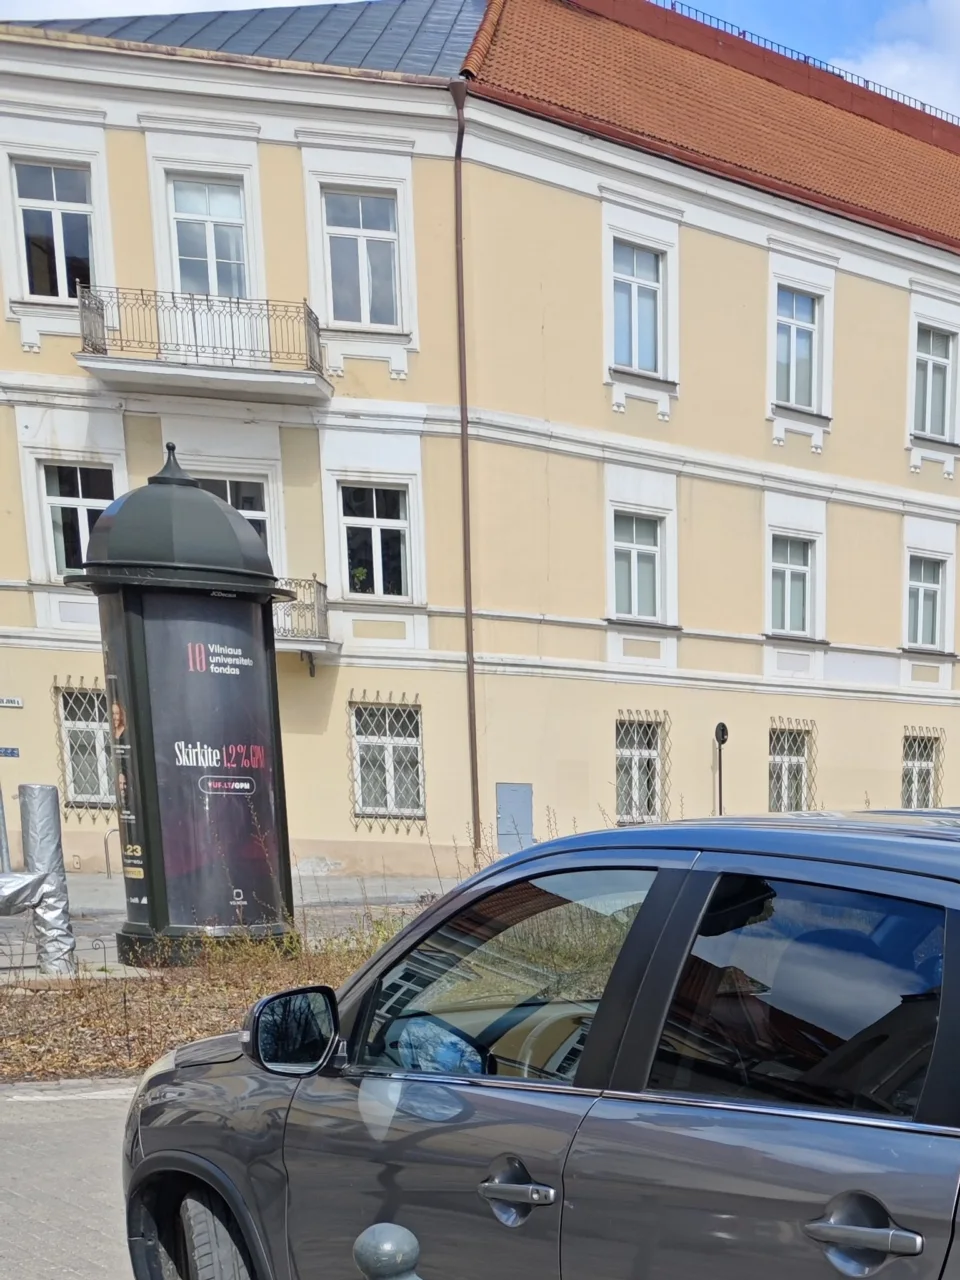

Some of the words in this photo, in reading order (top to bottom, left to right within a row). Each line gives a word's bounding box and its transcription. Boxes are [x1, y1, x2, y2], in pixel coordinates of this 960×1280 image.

[207, 643, 242, 655] Vilniaus
[187, 642, 207, 672] 10
[209, 655, 253, 666] universiteto
[210, 663, 240, 675] fondas
[174, 741, 221, 769] Skirkite
